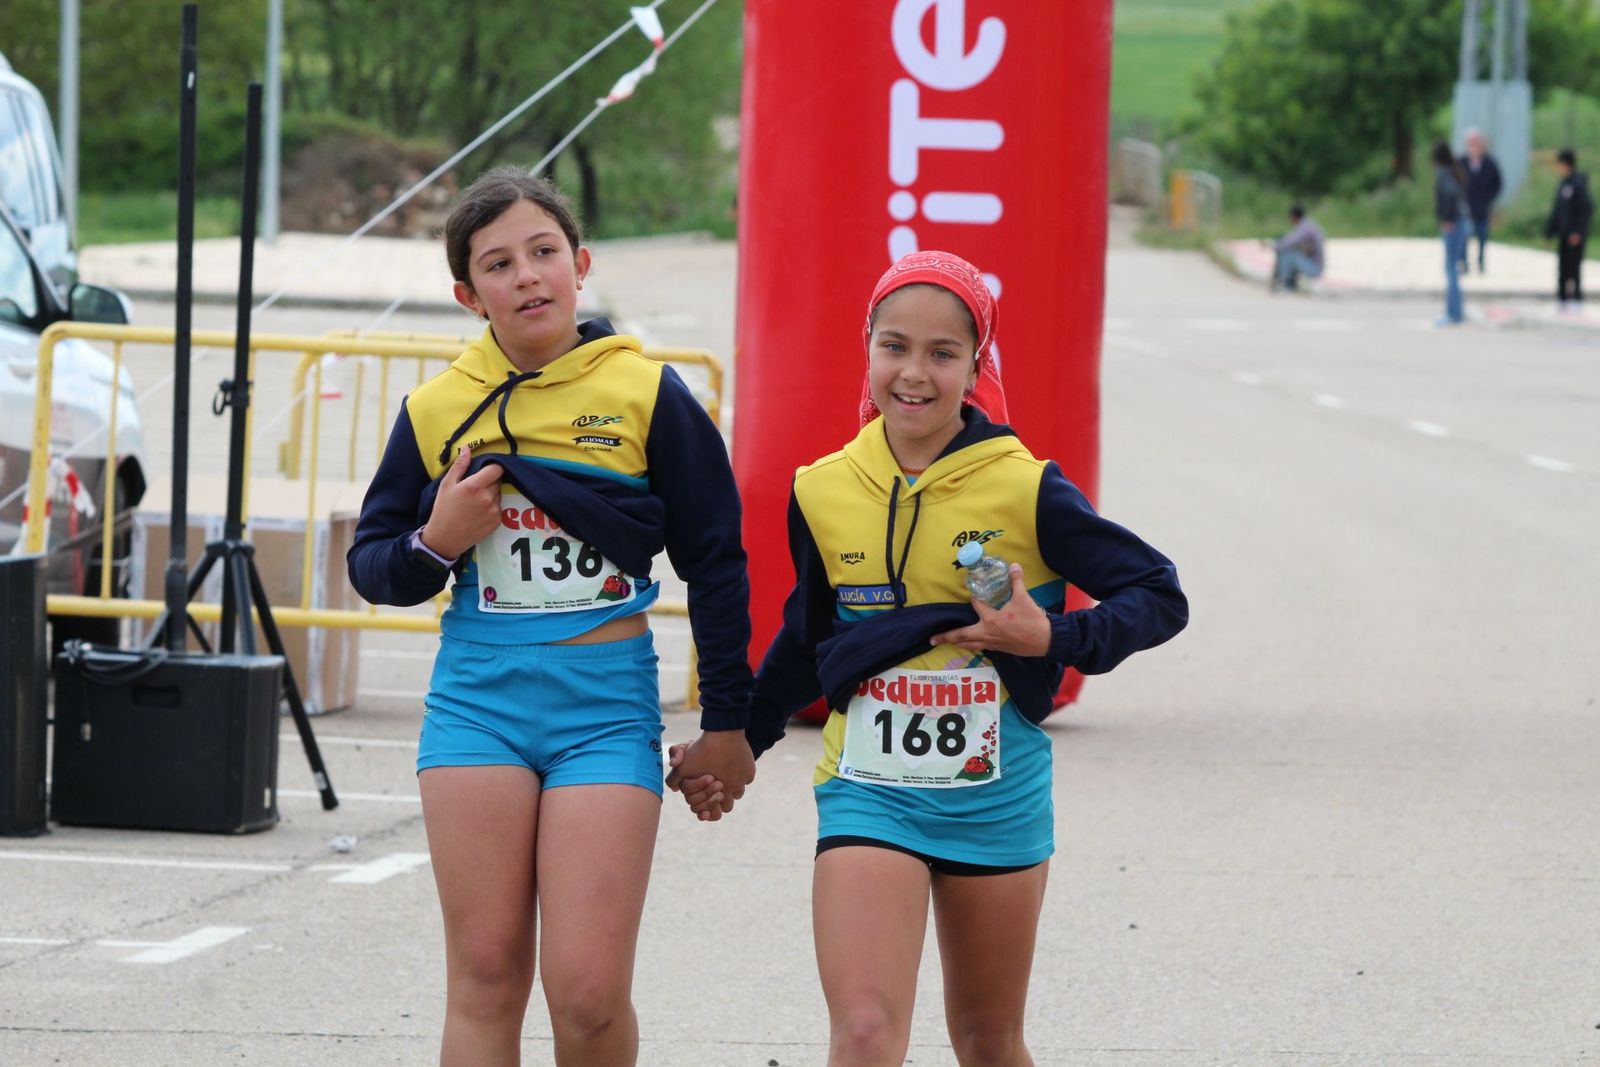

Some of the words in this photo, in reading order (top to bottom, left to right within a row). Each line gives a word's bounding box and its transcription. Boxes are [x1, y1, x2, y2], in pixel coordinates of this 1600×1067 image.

[511, 536, 604, 582] 136
[839, 587, 867, 602] LUCÍA
[874, 709, 967, 757] 168
